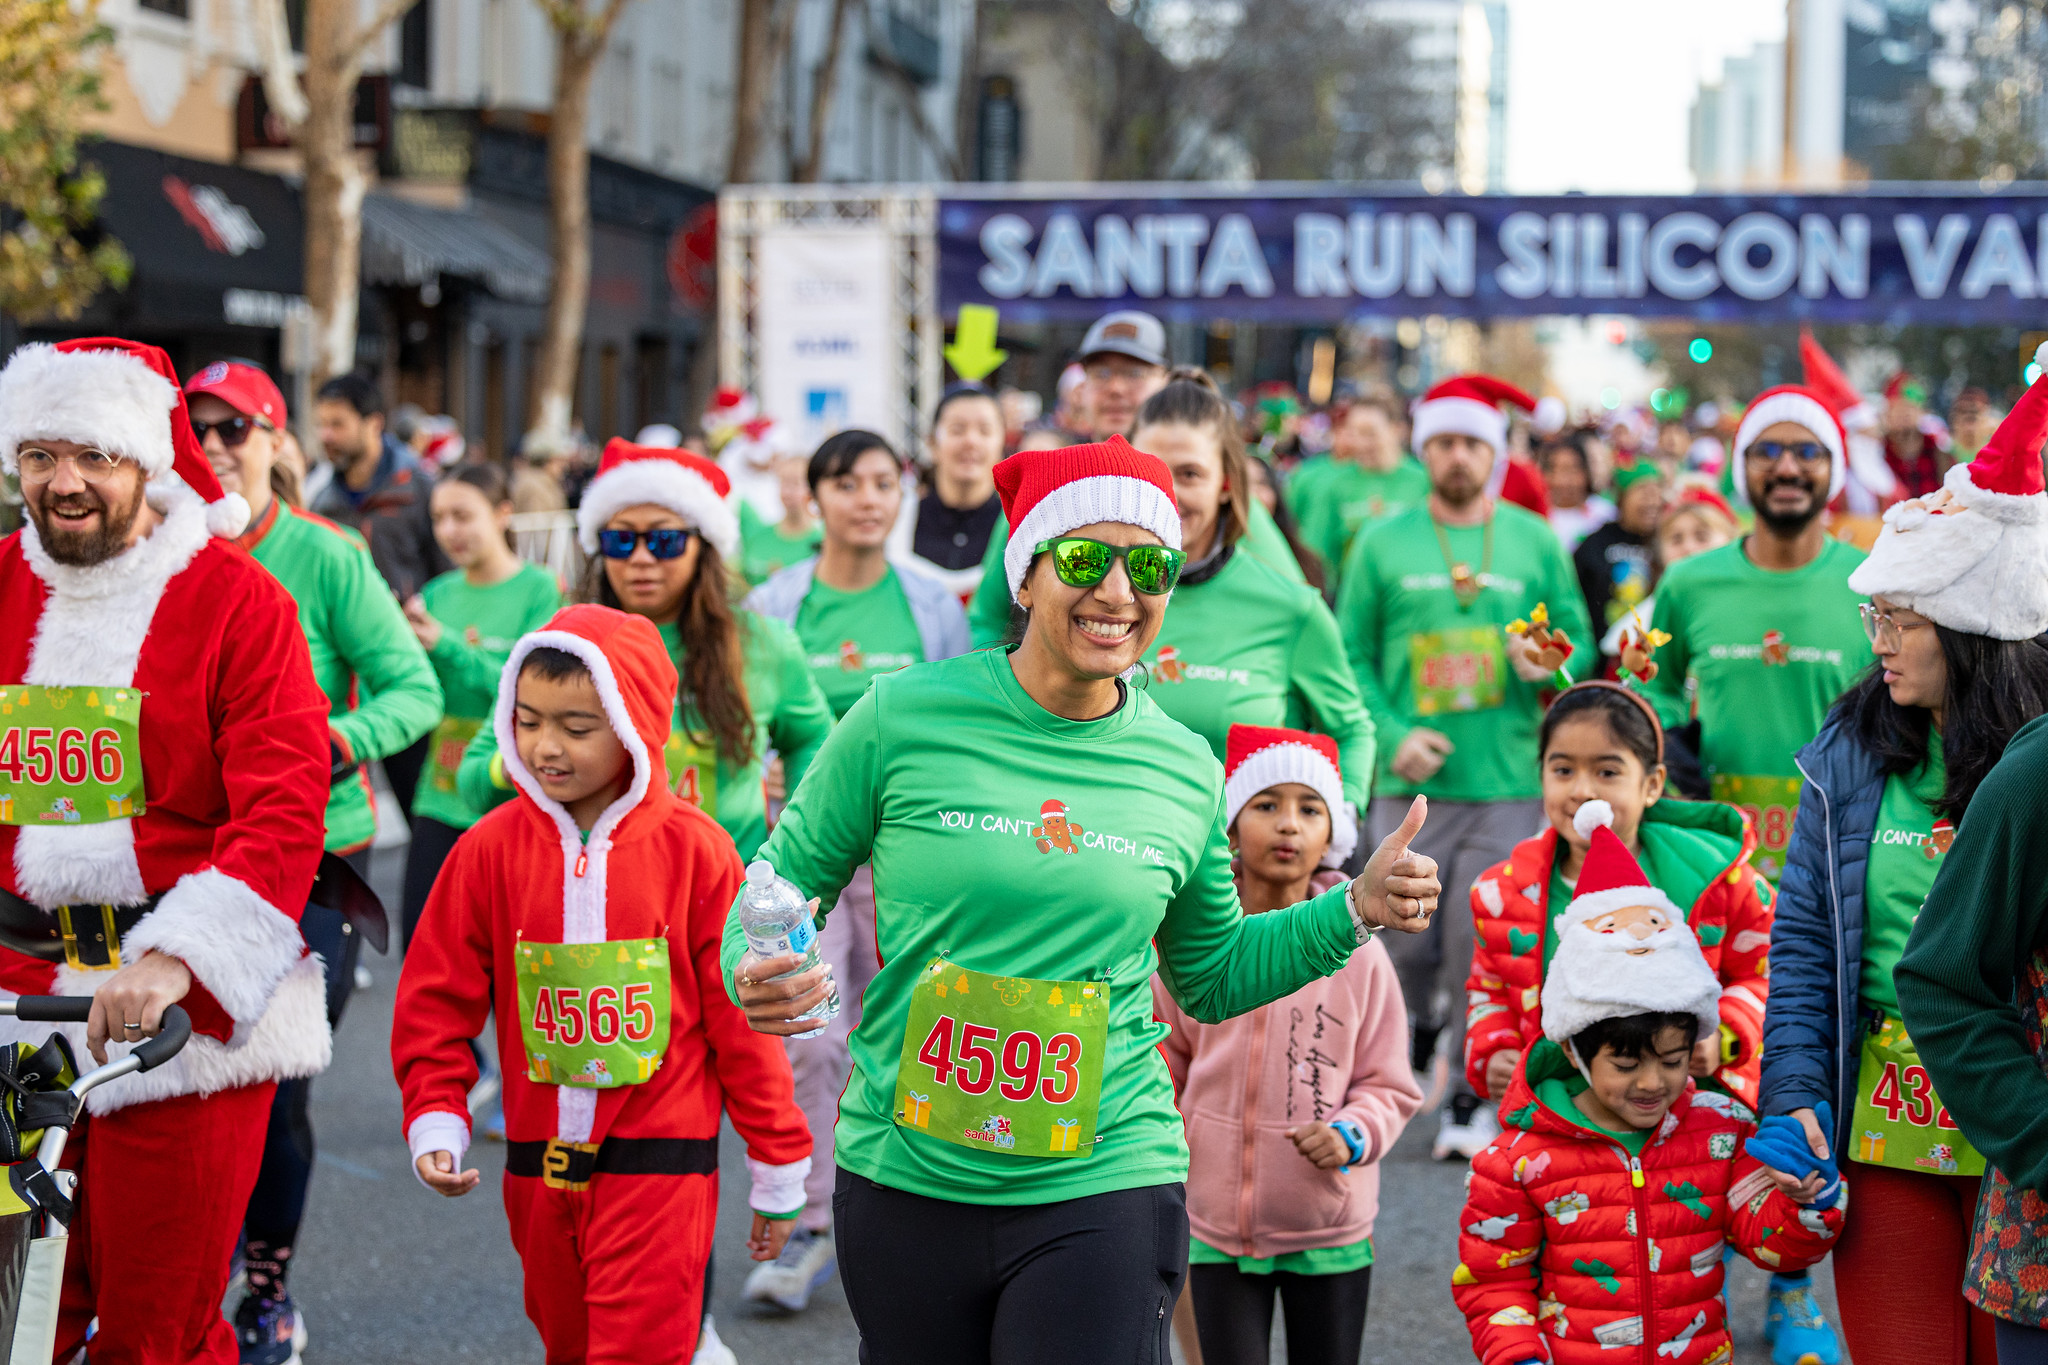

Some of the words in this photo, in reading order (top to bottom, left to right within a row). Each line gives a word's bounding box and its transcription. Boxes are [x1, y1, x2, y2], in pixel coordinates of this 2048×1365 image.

[979, 214, 1276, 298] SANTA
[1294, 213, 1476, 298] RUN
[1495, 211, 1871, 299] SILICON
[0, 726, 124, 785] 4566
[937, 810, 974, 829] YOU
[980, 814, 1036, 837] CAN'T
[1882, 829, 1927, 847] CAN'T
[1082, 831, 1137, 856] CATCH
[1141, 844, 1165, 867] ME
[533, 982, 656, 1047] 4565
[1313, 1003, 1345, 1039] Los
[918, 1014, 1083, 1105] 4593
